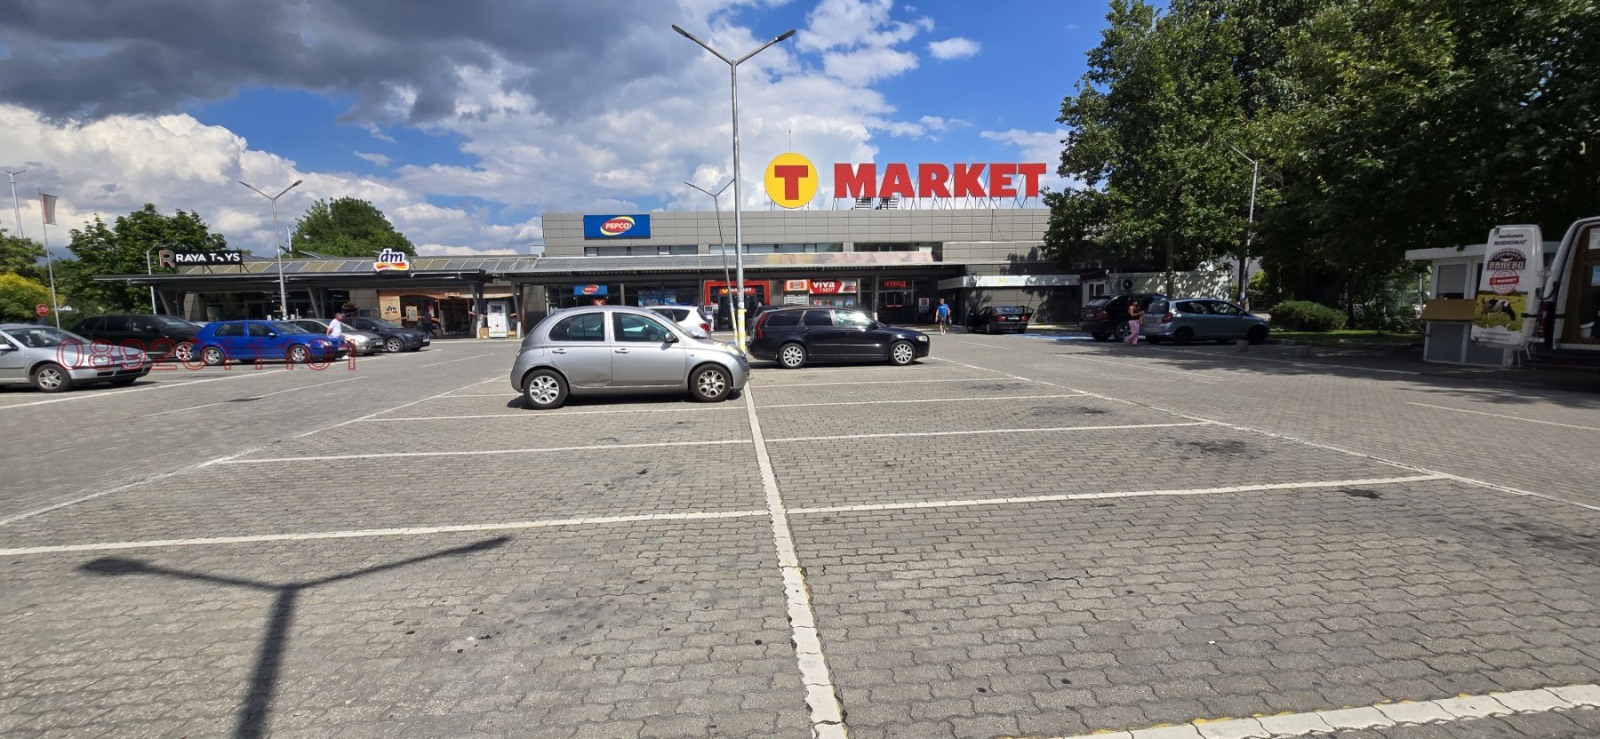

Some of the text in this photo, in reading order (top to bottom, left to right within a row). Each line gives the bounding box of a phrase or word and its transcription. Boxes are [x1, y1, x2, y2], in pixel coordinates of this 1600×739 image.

[774, 163, 1046, 200] T MARKET
[605, 222, 630, 230] PEPCO
[175, 253, 207, 263] RAYA
[380, 249, 403, 263] dm
